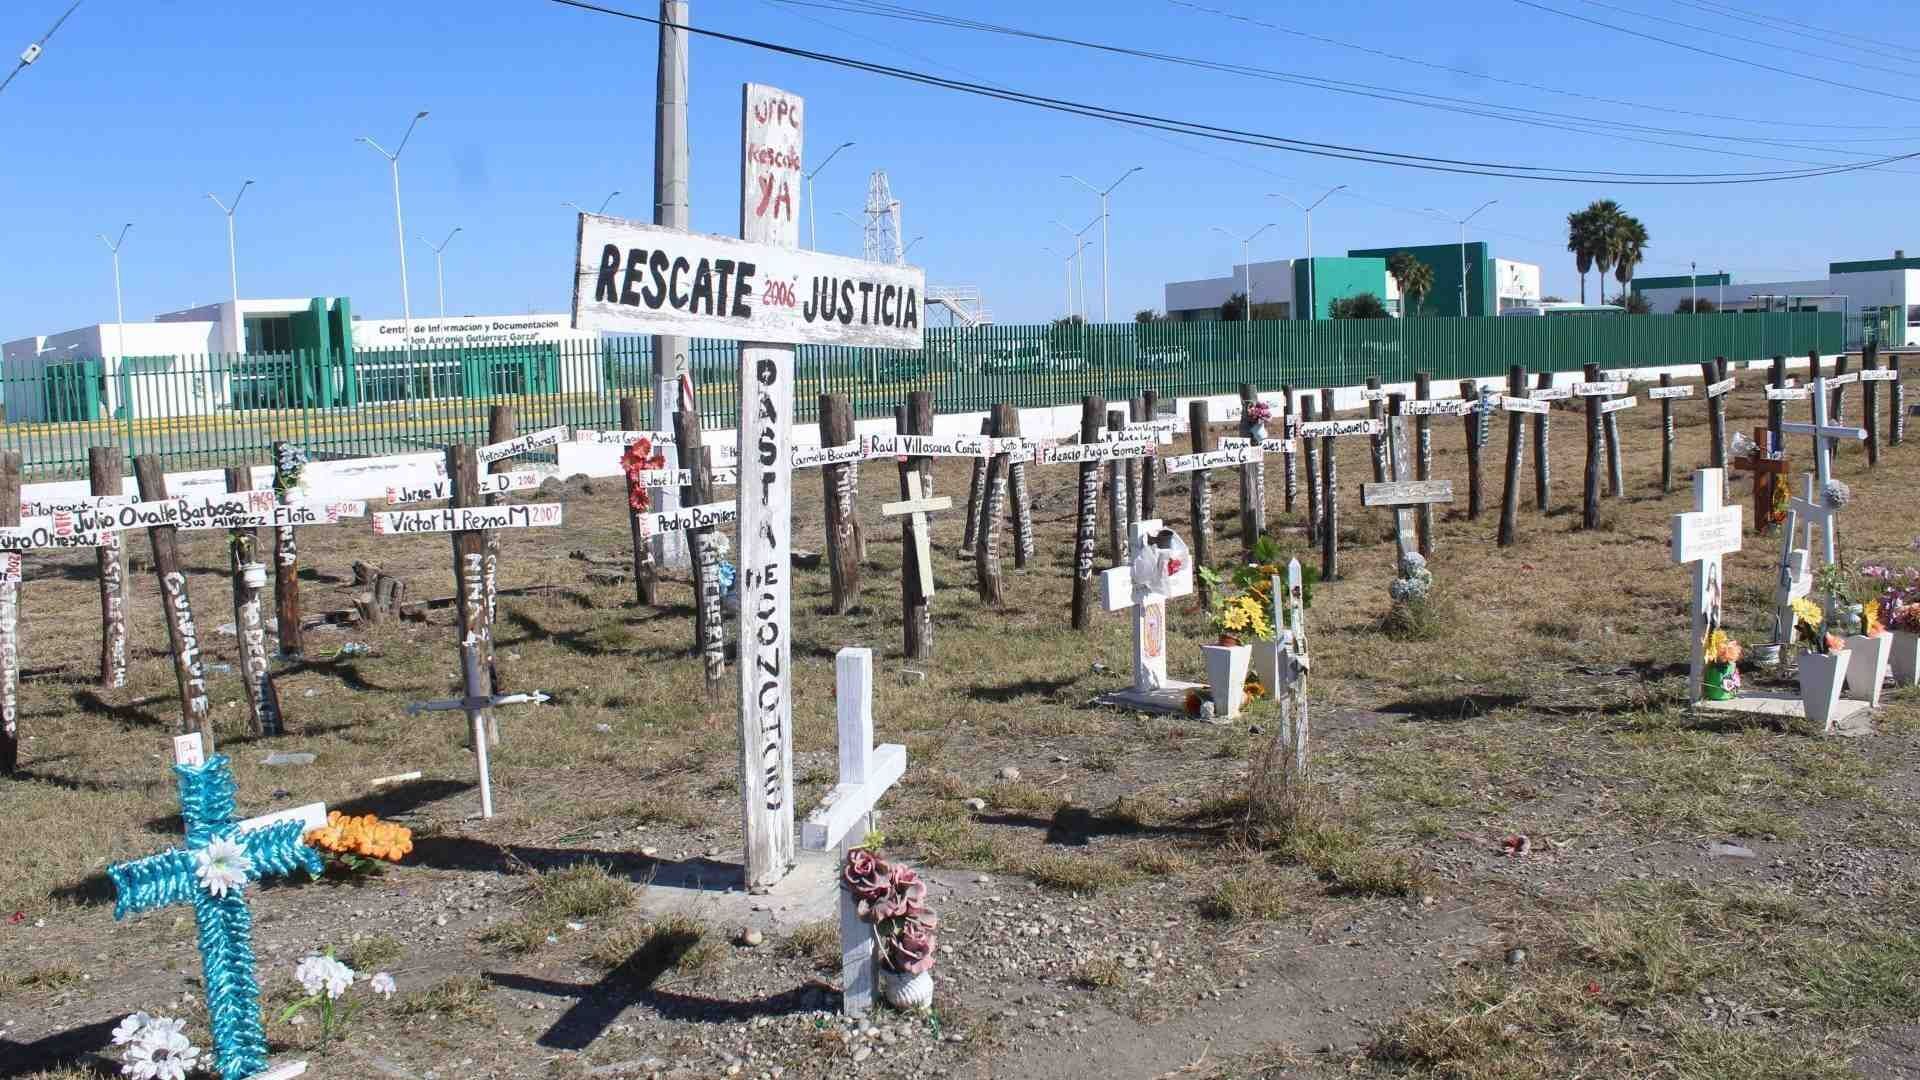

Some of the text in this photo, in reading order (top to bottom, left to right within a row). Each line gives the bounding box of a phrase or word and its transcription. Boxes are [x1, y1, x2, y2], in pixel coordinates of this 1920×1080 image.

[756, 172, 791, 222] YA
[595, 243, 918, 329] RESCATE 2006 JUSTICIA
[379, 325, 409, 335] Centr
[485, 325, 490, 333] y
[871, 434, 898, 455] Raúl
[902, 435, 951, 455] Villasana
[1083, 444, 1109, 461] Puga
[1110, 442, 1147, 457] Gomez
[498, 475, 510, 491] D
[399, 488, 432, 502] Jorge
[74, 507, 116, 534] Julio
[119, 504, 178, 528] Ovalle
[178, 494, 246, 523] Barbosa
[274, 508, 316, 525] Flota
[390, 510, 440, 532] Victor
[443, 509, 461, 530] H.
[462, 509, 507, 531] Reyna
[508, 505, 530, 527] M
[658, 508, 737, 532] Pedro Ramirez
